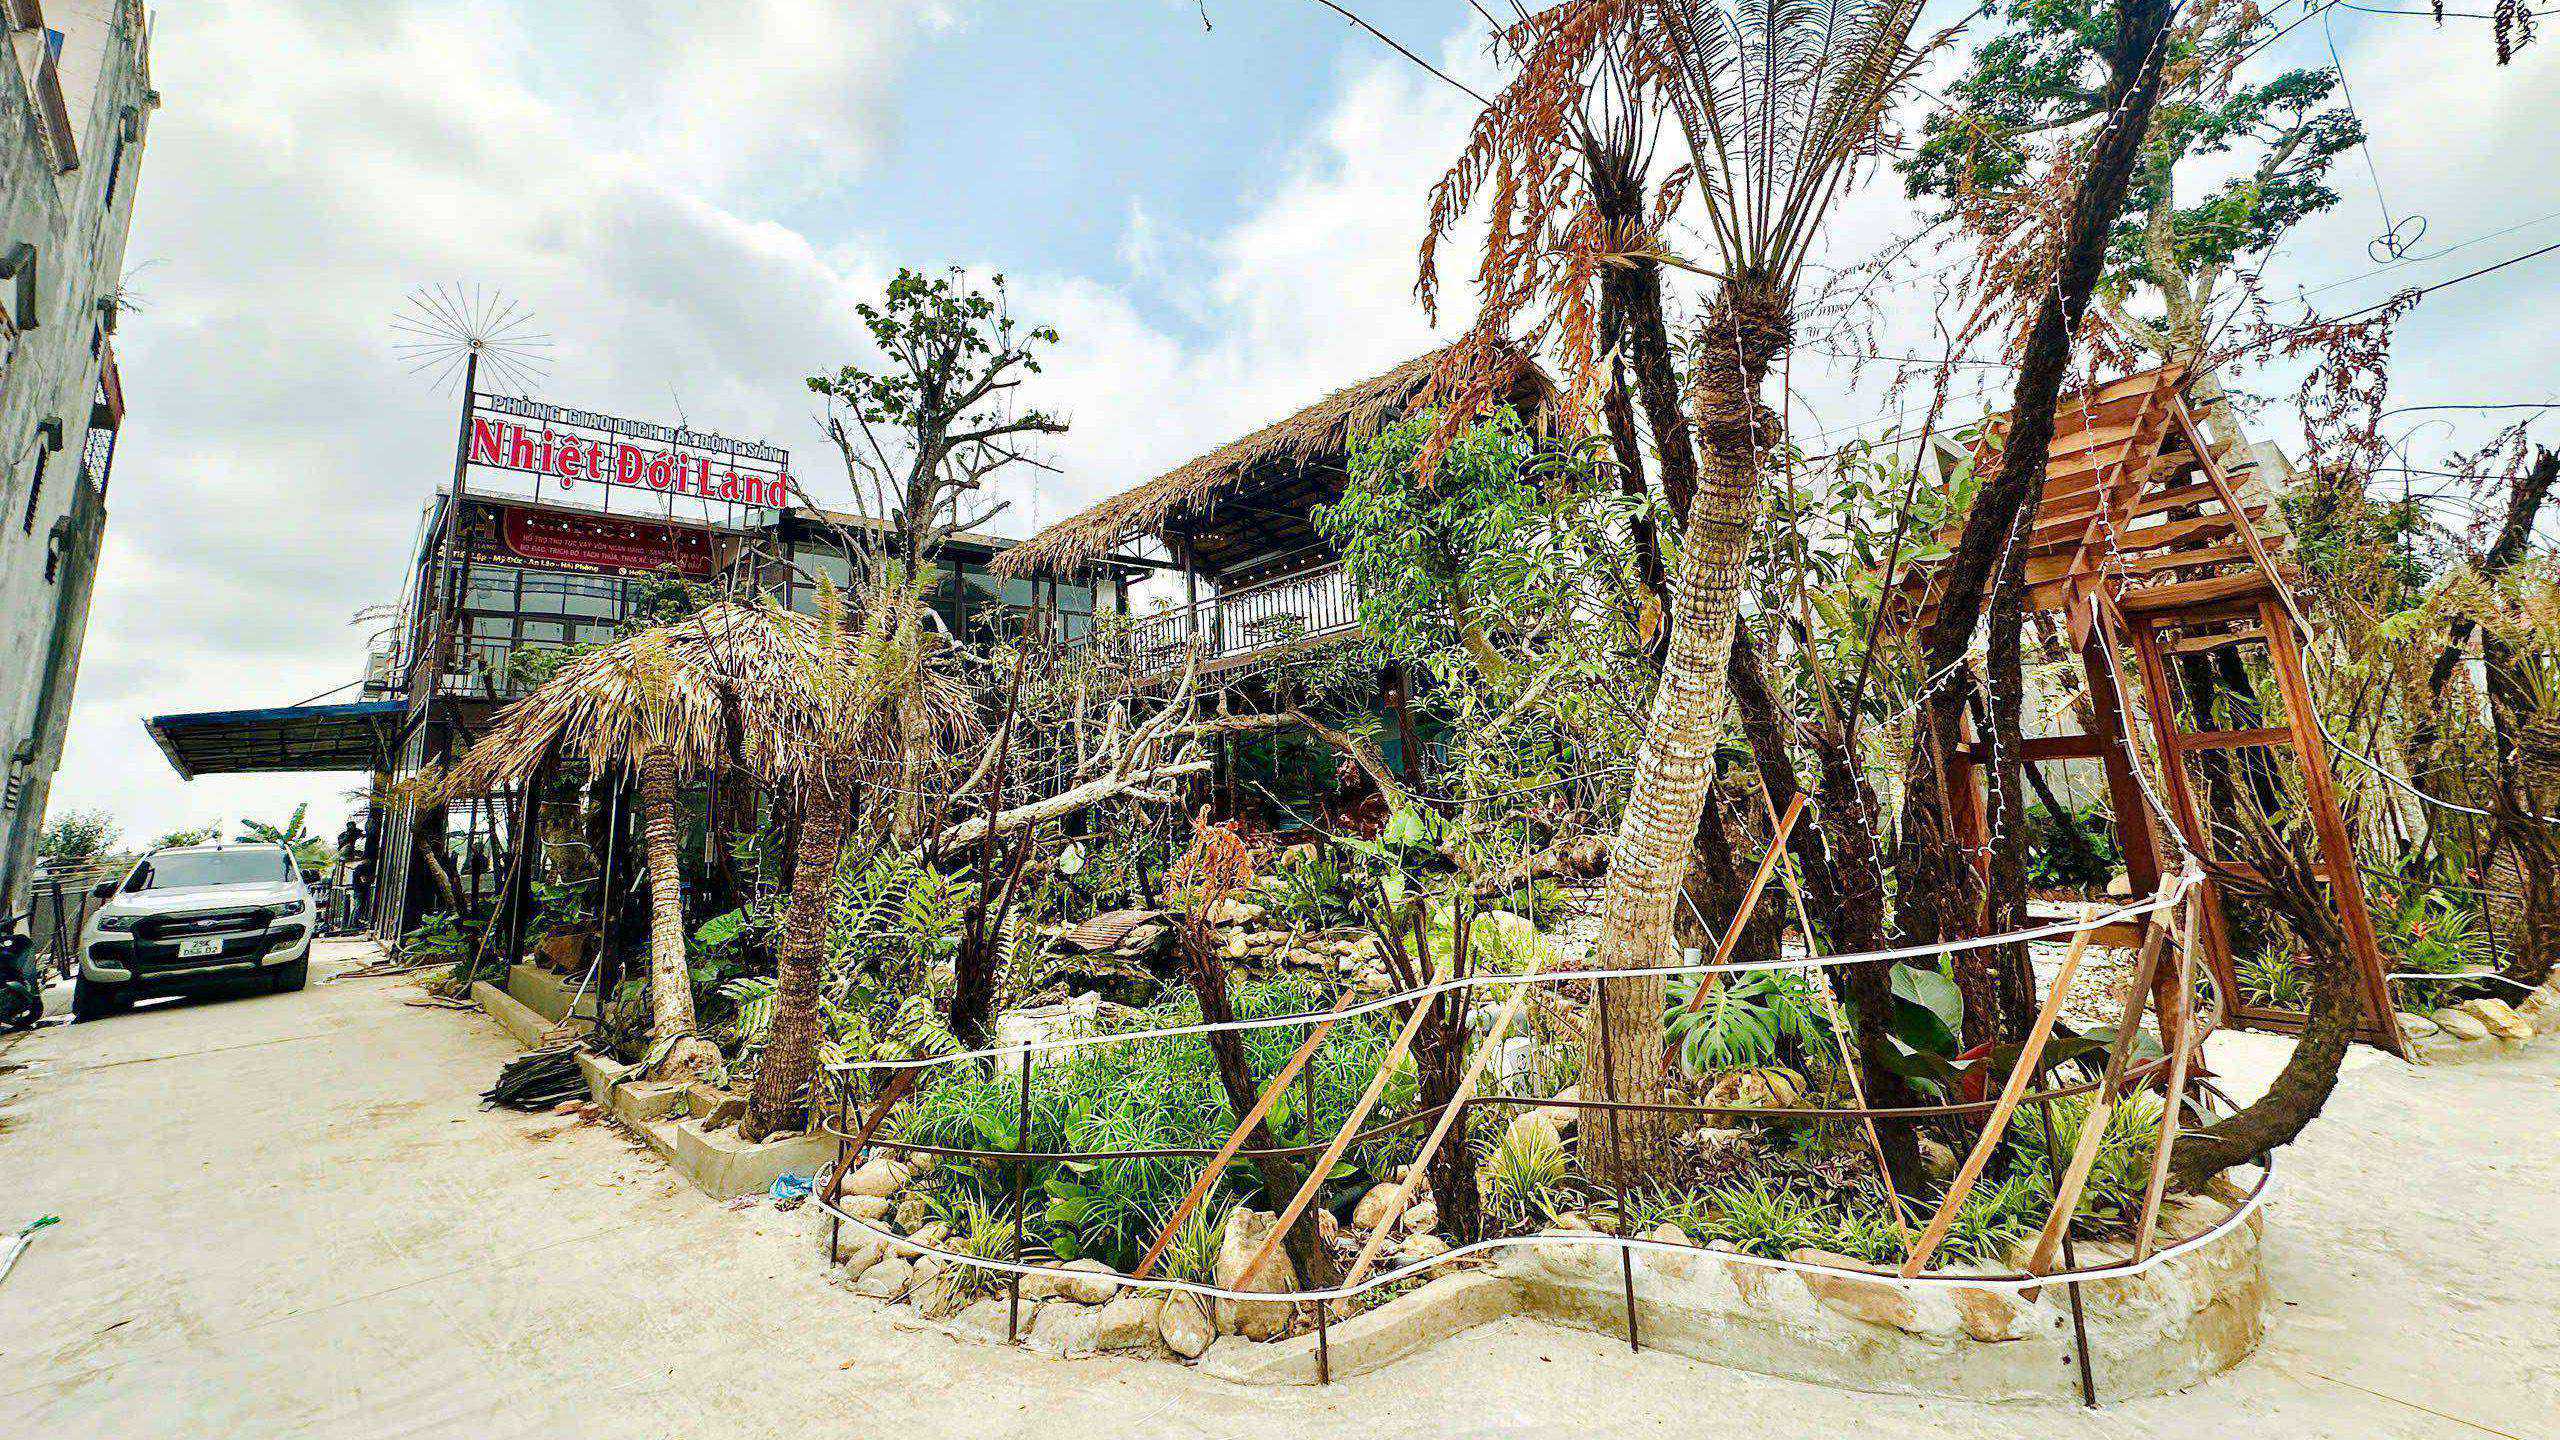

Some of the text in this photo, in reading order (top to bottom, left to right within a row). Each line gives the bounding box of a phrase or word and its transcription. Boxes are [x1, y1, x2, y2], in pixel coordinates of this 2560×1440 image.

[491, 393, 561, 421] PHÒNG
[567, 408, 612, 432] GIAO
[617, 417, 659, 440] DỊCH
[470, 416, 788, 509] Nhiệt Đới Land
[528, 558, 539, 566] An
